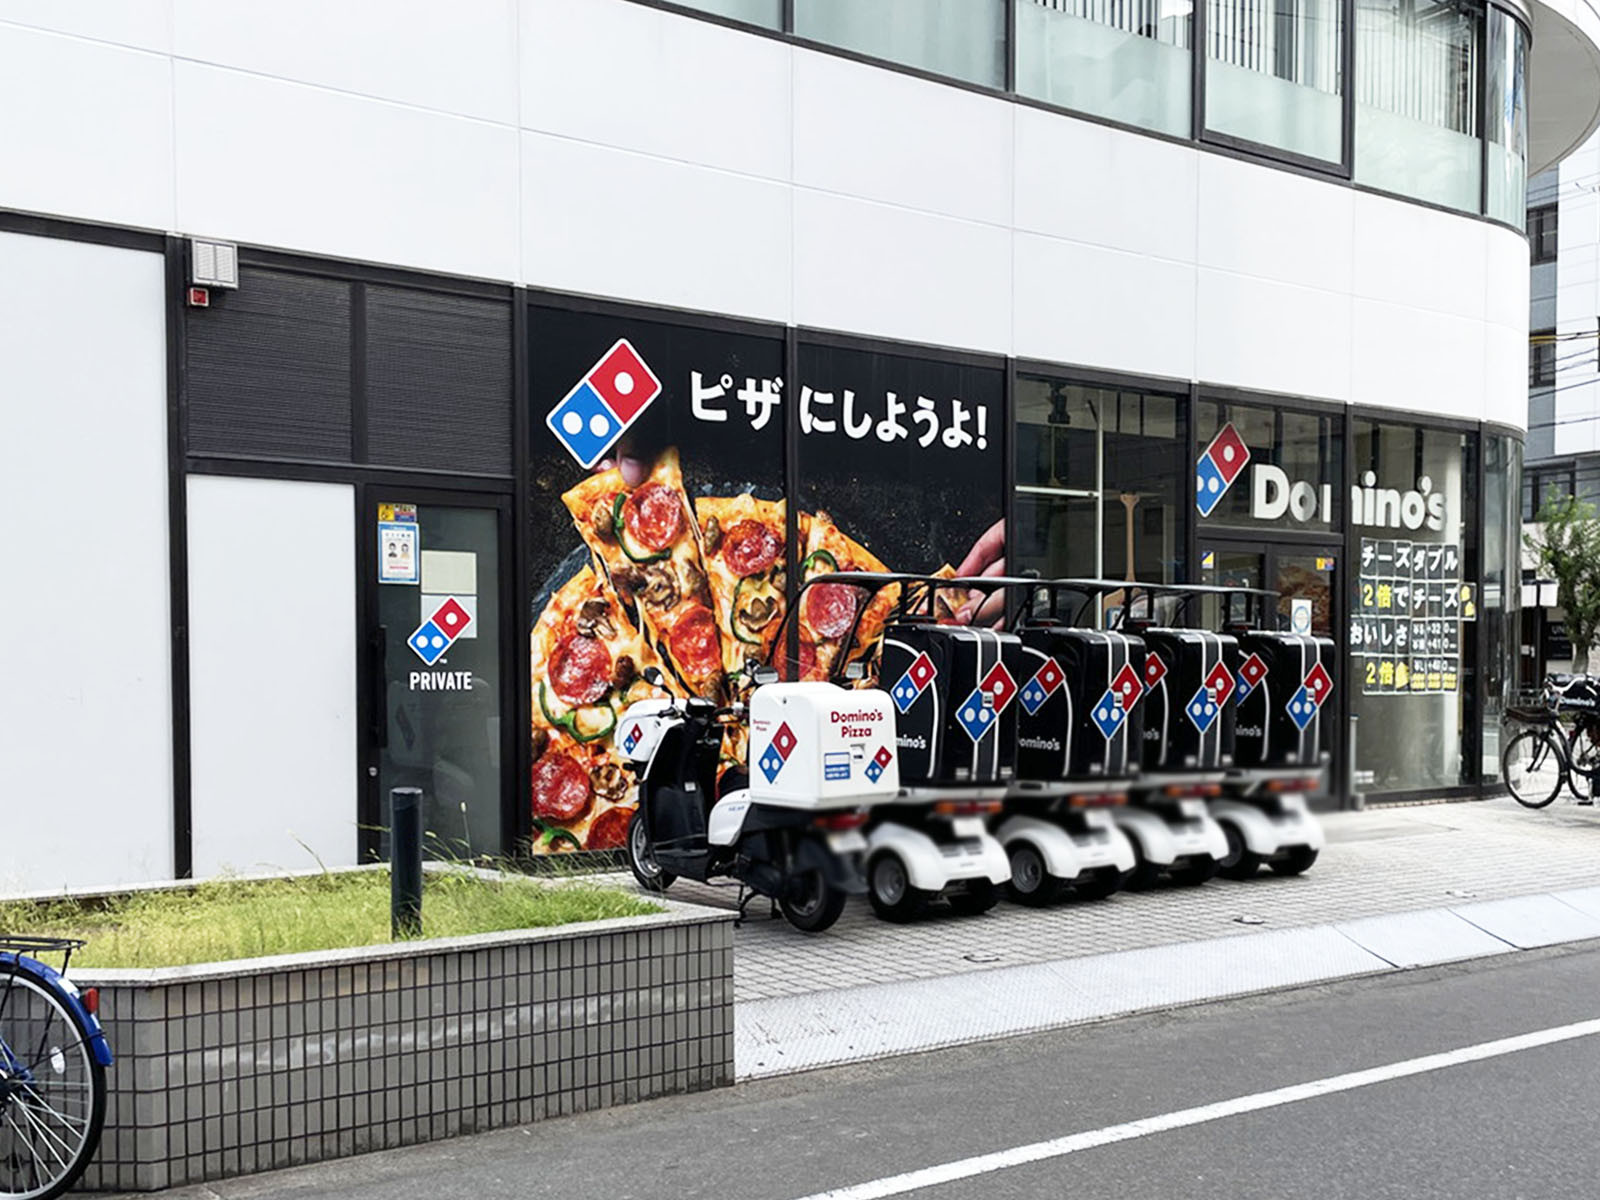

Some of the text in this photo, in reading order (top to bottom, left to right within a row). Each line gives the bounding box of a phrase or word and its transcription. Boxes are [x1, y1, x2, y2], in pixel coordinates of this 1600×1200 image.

[691, 371, 987, 450] ピザにしようよ!
[1350, 622, 1408, 646] おいしさ
[410, 671, 473, 690] PRIVATE
[830, 709, 883, 723] Domino's
[841, 726, 872, 738] Pizza
[1019, 736, 1061, 751] omino's
